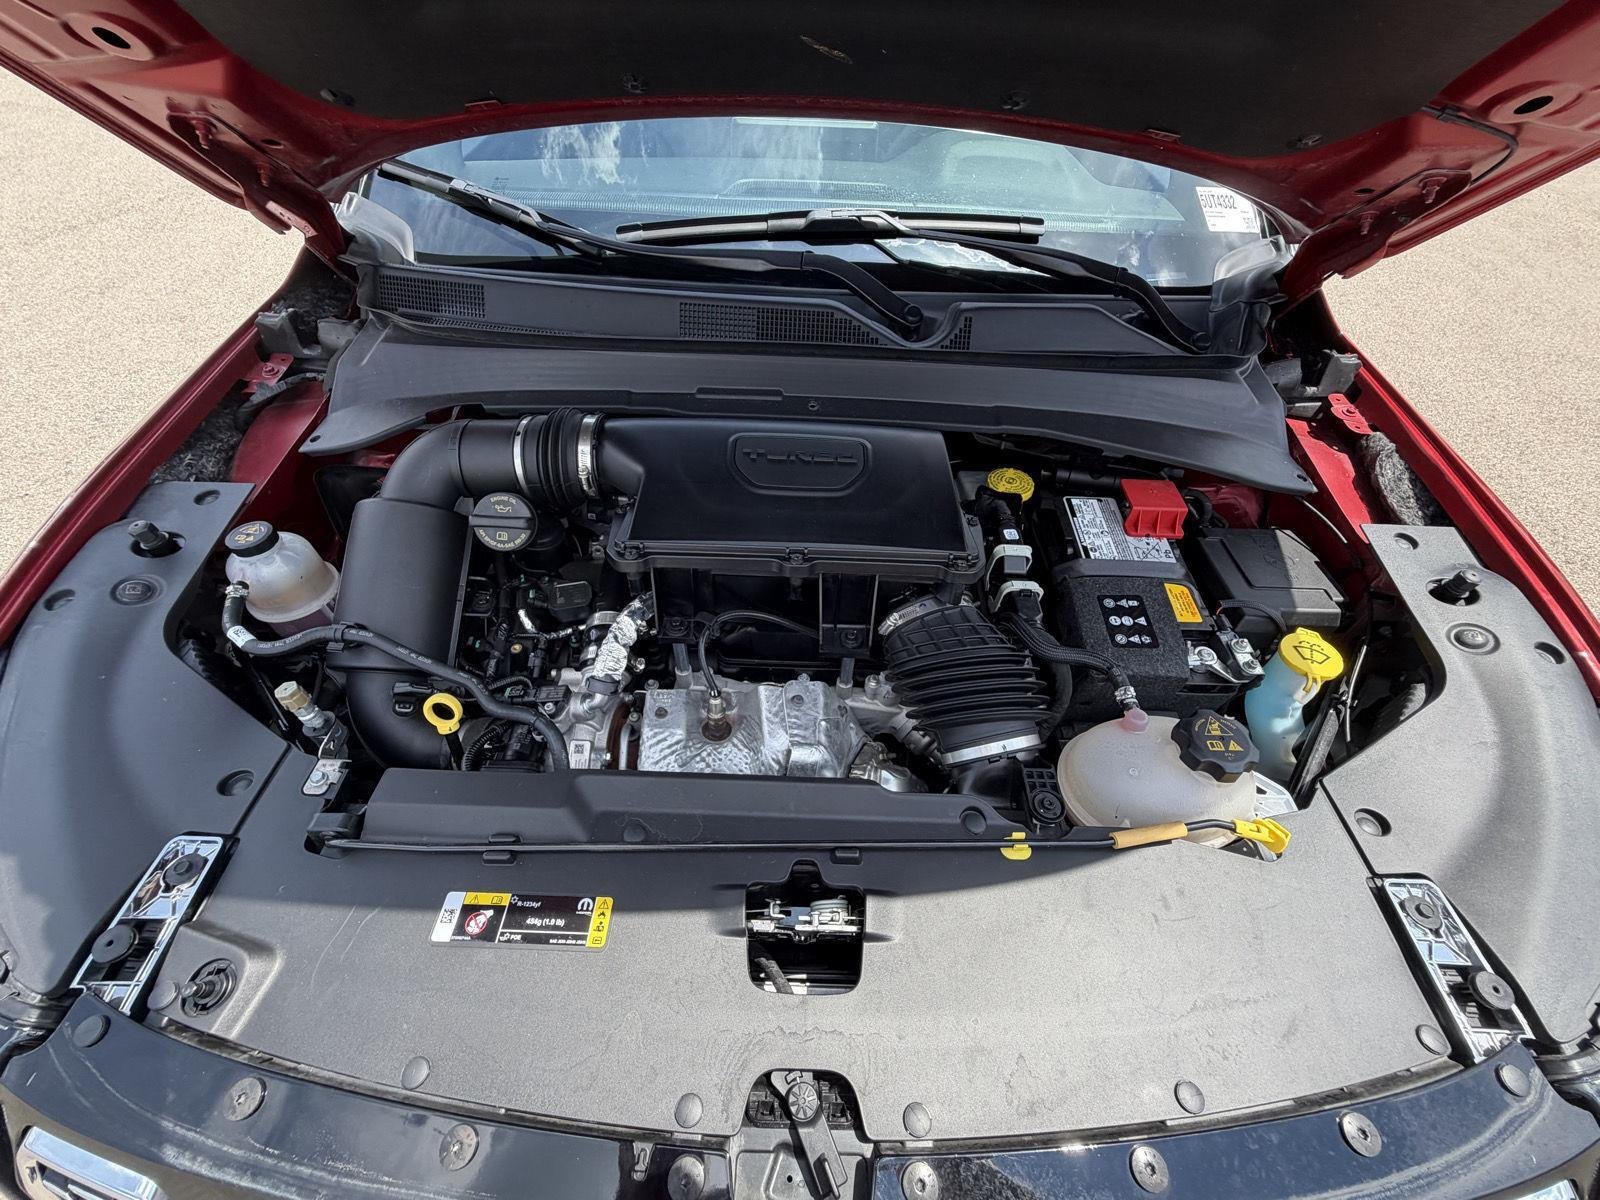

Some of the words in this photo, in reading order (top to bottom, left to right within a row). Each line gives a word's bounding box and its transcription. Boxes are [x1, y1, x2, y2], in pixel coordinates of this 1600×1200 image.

[509, 497, 517, 505] OIL
[526, 917, 542, 926] 454g
[542, 918, 556, 926] (1.0
[556, 918, 565, 927] lb)
